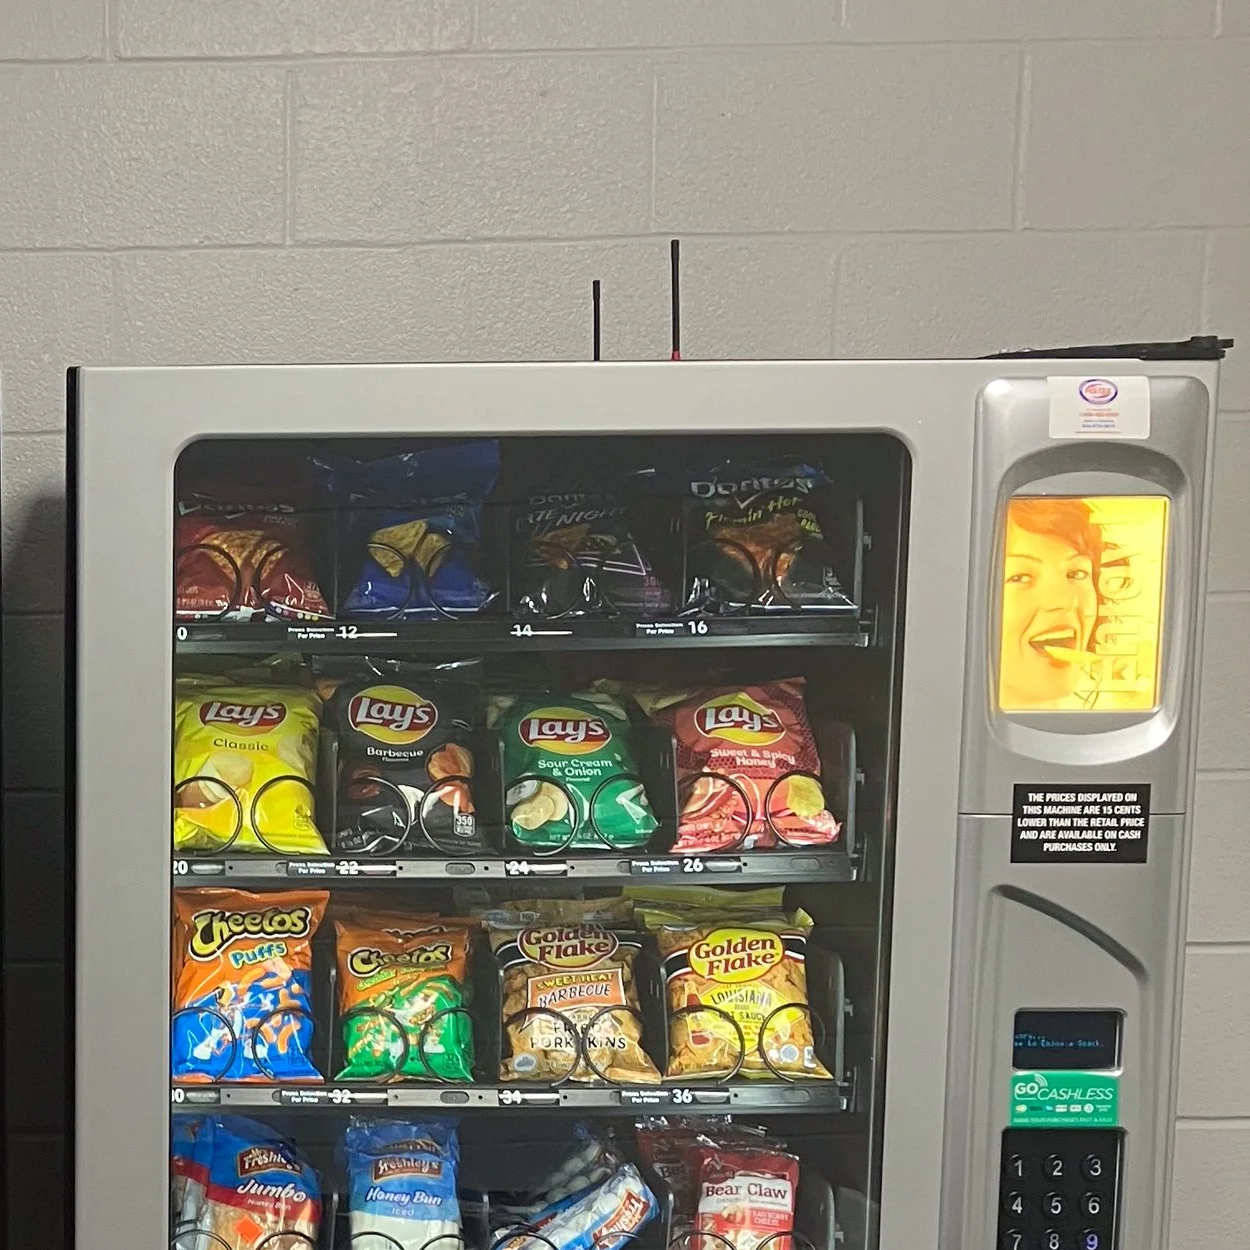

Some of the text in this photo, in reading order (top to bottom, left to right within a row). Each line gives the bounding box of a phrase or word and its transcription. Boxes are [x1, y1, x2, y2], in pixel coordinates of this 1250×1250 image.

[688, 621, 708, 634] 16
[205, 701, 280, 727] Lay's
[356, 698, 430, 731] Lay's
[705, 705, 778, 731] Lay's
[528, 717, 606, 744] Lay's
[213, 738, 269, 751] Classic
[366, 746, 424, 759] Barbecue
[538, 758, 613, 770] Sour Cream
[710, 748, 796, 766] Sweet & Spicy
[736, 757, 776, 769] Honey
[552, 766, 602, 777] & Onion
[1028, 793, 1137, 802] THE PRICES DISPLAYED ON
[1023, 805, 1141, 814] THIS MACHINE ARE 15 CENTS
[456, 816, 472, 826] 350
[1017, 818, 1144, 827] LOWER THAN THE RETAIL PRICE
[1020, 830, 1141, 839] AND ARE AVAILABLE ON CASH
[1043, 843, 1117, 852] PURCHASES ONLY.
[339, 861, 358, 874] 22
[510, 862, 529, 875] 24
[683, 859, 703, 872] 26
[190, 906, 311, 957] Cheetos
[524, 924, 609, 946] Golden
[231, 942, 288, 968] Puffs
[538, 936, 605, 961] Flake
[693, 936, 776, 958] Golden
[351, 944, 450, 974] Cheetos
[706, 952, 775, 978] Flake
[536, 972, 613, 991] SWEET HEAT
[538, 983, 611, 1007] BARBECUE
[530, 1036, 574, 1048] PORK
[672, 1089, 692, 1103] 36
[1014, 1082, 1038, 1094] GO
[1037, 1088, 1114, 1100] CASHLESS
[1014, 1160, 1022, 1176] 1
[1052, 1160, 1063, 1176] 2
[1090, 1160, 1101, 1176] 3
[237, 1179, 307, 1202] Jumbo
[366, 1186, 442, 1206] Honey Bun
[705, 1183, 788, 1200] Bear Claw
[392, 1208, 414, 1216] Iced
[1012, 1197, 1022, 1213] 4
[1051, 1197, 1062, 1213] 5
[1088, 1197, 1100, 1213] 6
[1013, 1234, 1022, 1250] 7
[1050, 1234, 1059, 1250] 8
[1086, 1234, 1098, 1250] 9
